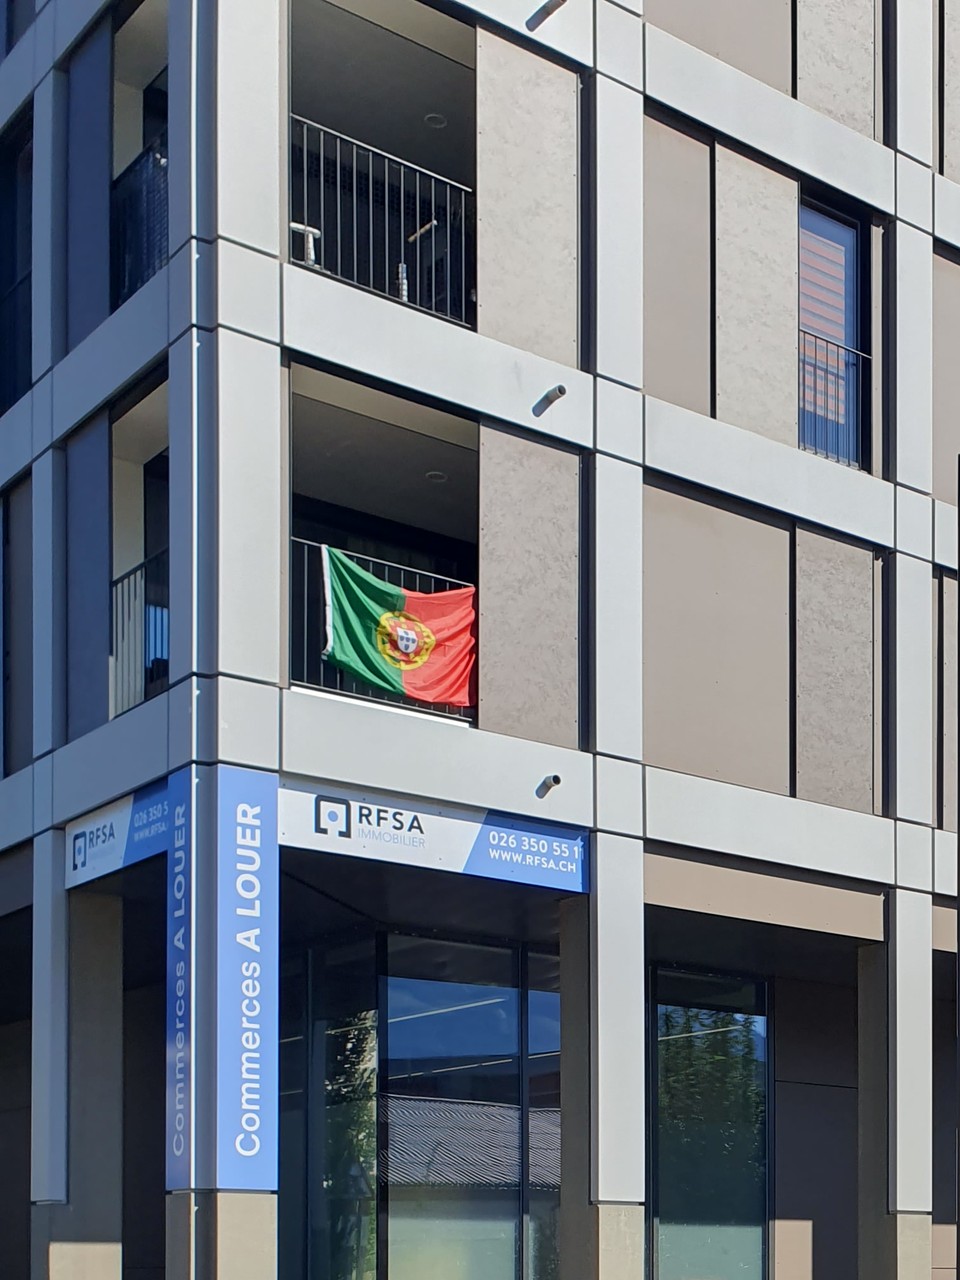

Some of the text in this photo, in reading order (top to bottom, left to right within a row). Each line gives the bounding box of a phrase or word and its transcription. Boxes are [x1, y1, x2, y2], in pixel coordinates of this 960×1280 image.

[358, 805, 425, 834] RFSA
[88, 821, 116, 849] RFSA
[358, 828, 426, 849] IMMOBILIER
[489, 831, 517, 848] 026
[521, 836, 548, 853] 350
[552, 842, 570, 857] 55
[489, 848, 577, 873] WWW.RFSA.CH
[173, 803, 186, 1157] Commerces A LOUER
[235, 803, 261, 1157] Commerces A LOUER
